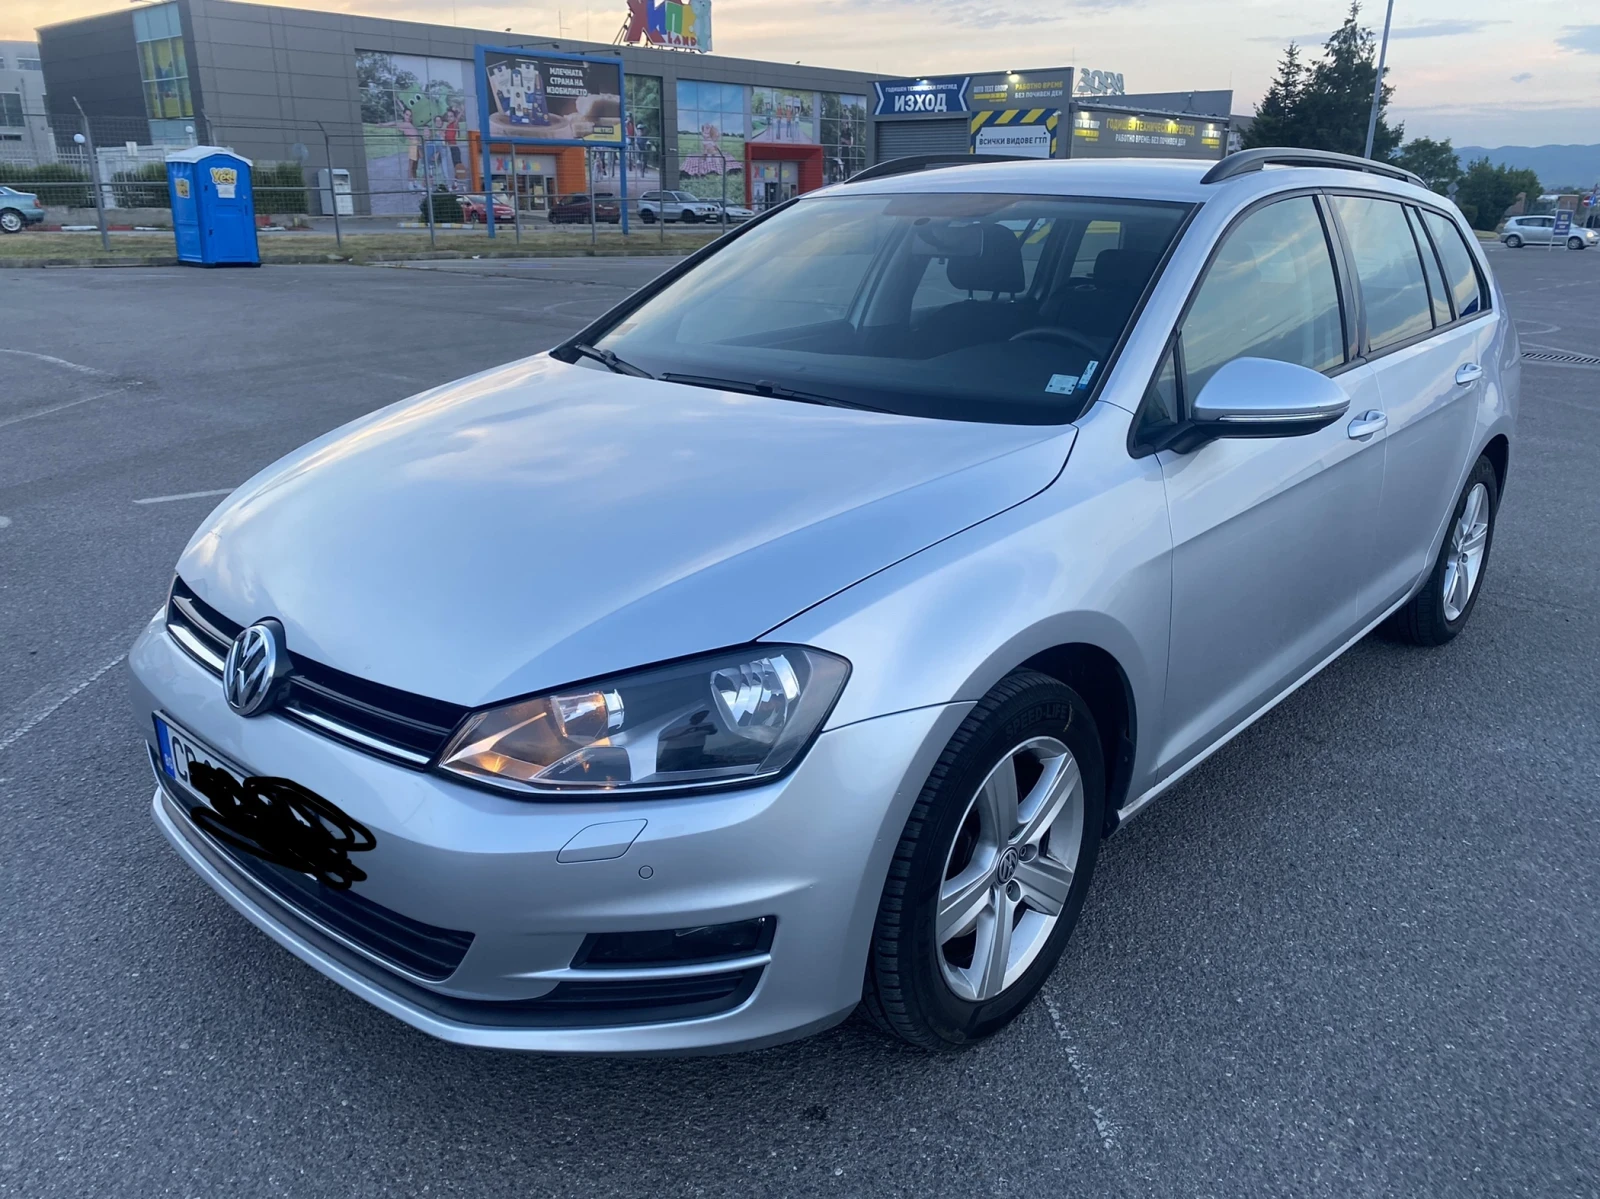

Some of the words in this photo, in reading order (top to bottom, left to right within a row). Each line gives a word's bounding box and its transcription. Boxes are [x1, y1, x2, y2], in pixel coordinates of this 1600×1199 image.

[667, 31, 697, 46] LAND
[550, 67, 584, 77] МЛЕЧНАТА
[550, 77, 573, 86] СТРАНА
[574, 79, 584, 87] НА
[1015, 82, 1042, 91] РАБОТНО
[1042, 81, 1063, 89] ВРЕМЕ
[894, 93, 947, 112] ИЗХОД
[1006, 137, 1033, 145] ВИДОВЕ
[1034, 136, 1048, 144] ГТП
